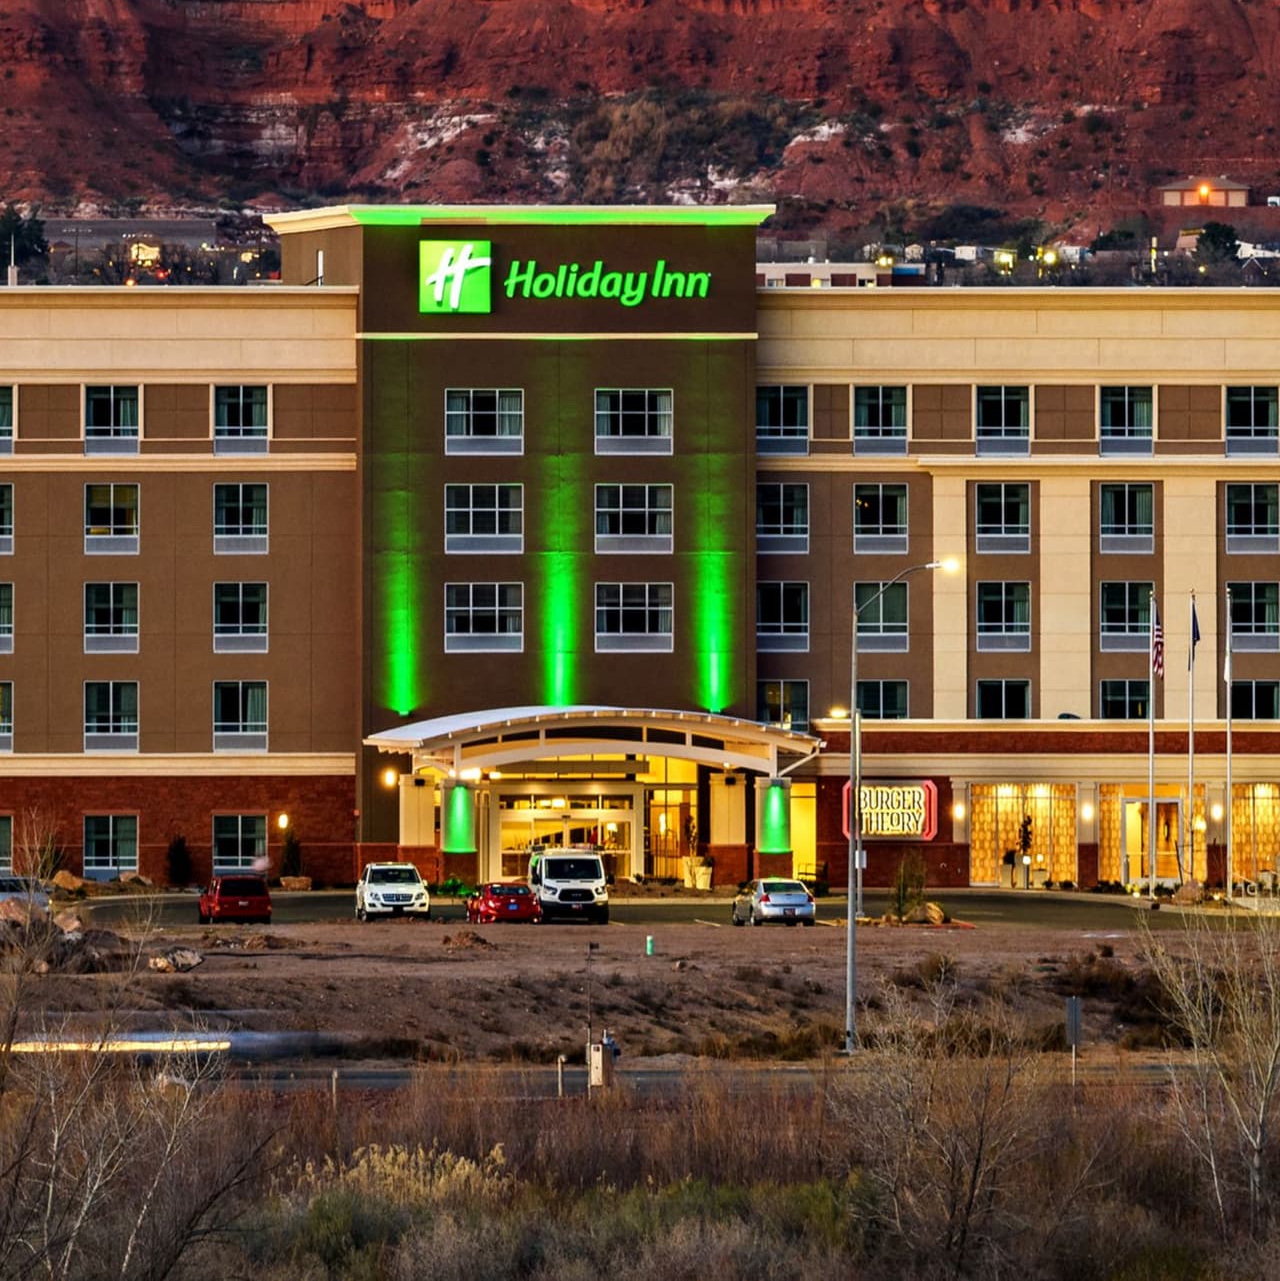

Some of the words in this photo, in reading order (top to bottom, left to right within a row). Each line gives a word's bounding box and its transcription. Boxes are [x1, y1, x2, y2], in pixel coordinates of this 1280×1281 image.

[504, 260, 648, 306] Holiday
[652, 259, 710, 298] Inn
[860, 789, 922, 810] BURGER
[860, 811, 922, 831] THEORY
